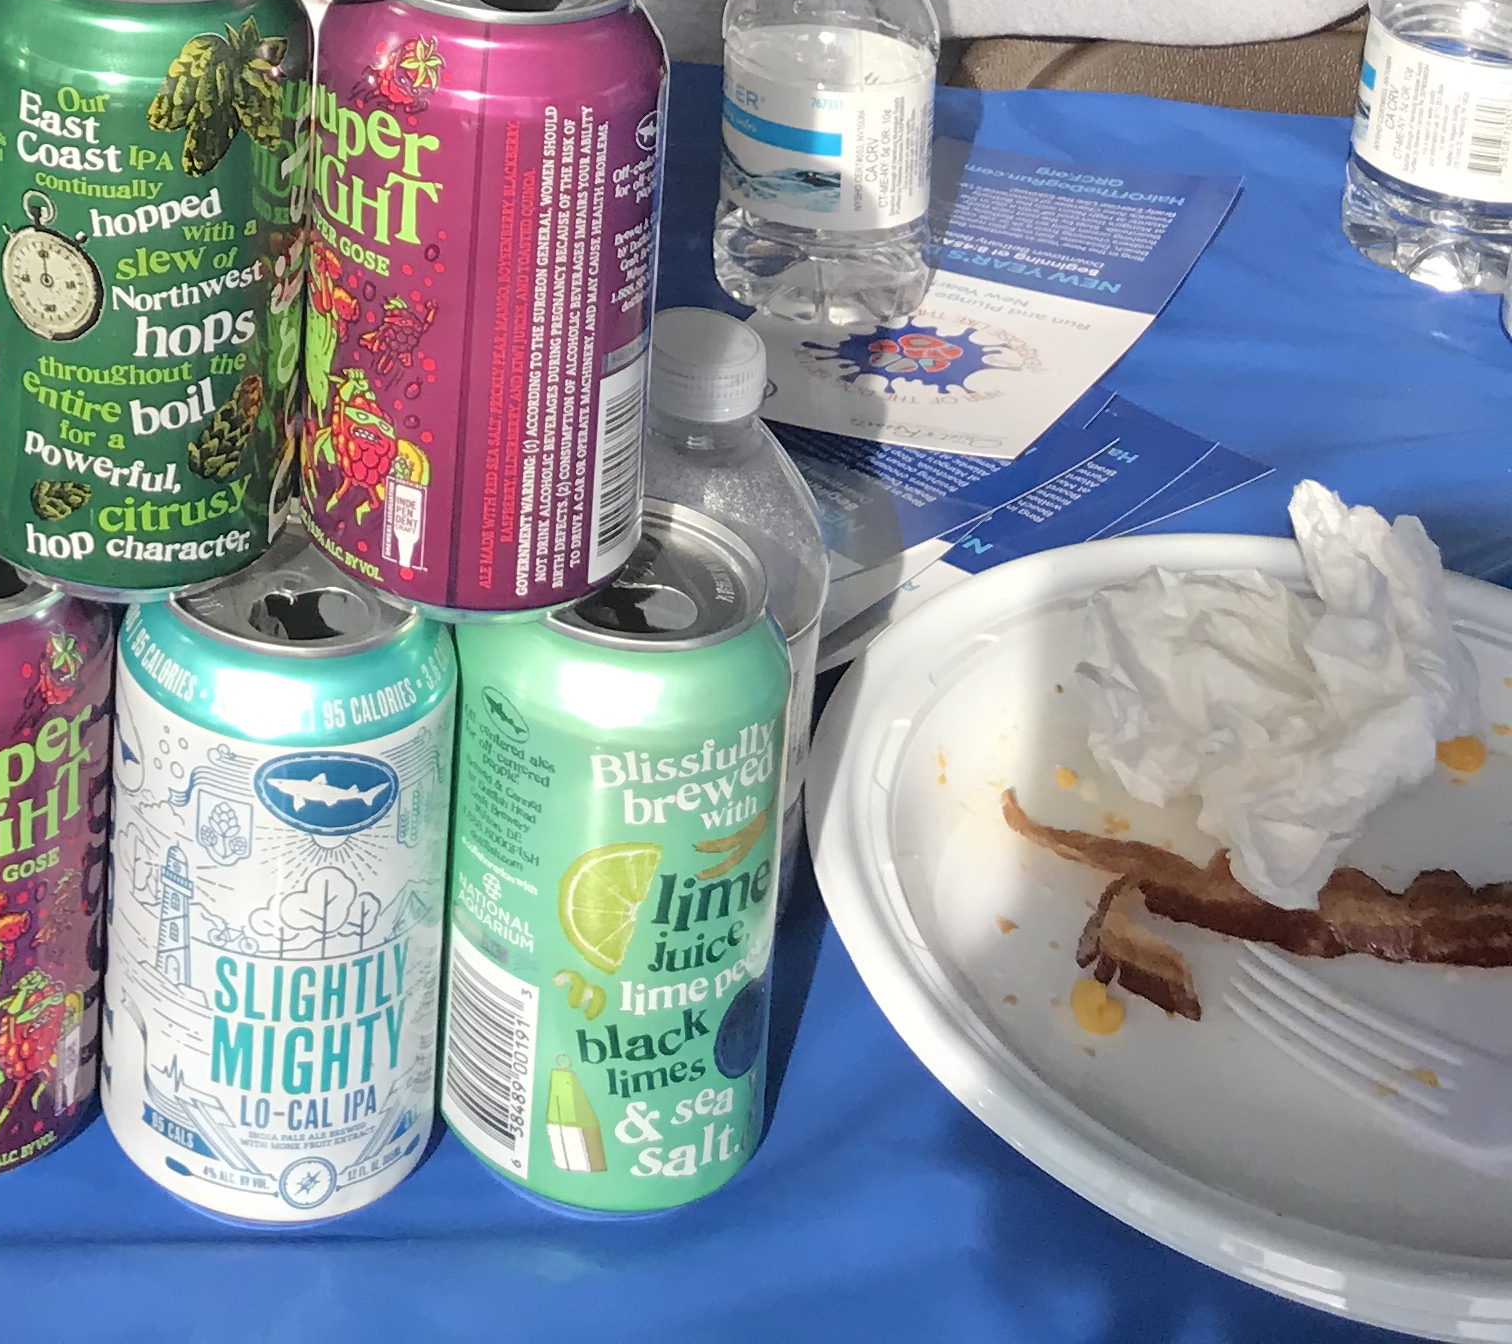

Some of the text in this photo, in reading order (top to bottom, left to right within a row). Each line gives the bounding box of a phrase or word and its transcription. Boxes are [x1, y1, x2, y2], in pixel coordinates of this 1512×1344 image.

[20, 89, 101, 145] East
[58, 86, 111, 114] Our
[17, 131, 175, 173] Coast IPA
[544, 105, 558, 158] SHOULD
[541, 160, 555, 207] WOMEN
[865, 137, 879, 184] CA CRV
[35, 171, 164, 201] continually
[90, 186, 223, 239] hopped
[182, 217, 236, 243] with
[115, 246, 239, 281] slew of
[339, 236, 391, 278] GOSE
[946, 248, 1122, 294] NEW YEAR'S
[112, 259, 264, 314] Northwest
[533, 268, 548, 324] SURGEON
[934, 291, 1004, 313] Plunge
[132, 308, 257, 359] hops
[532, 325, 545, 350] THE
[1008, 307, 1048, 323] and
[37, 352, 247, 386] throughout the
[530, 351, 543, 370] TO
[23, 369, 217, 436] entire boil
[525, 372, 542, 438] ACCORDING
[59, 418, 97, 445] for
[24, 430, 182, 495] powerful,
[520, 454, 537, 514] WARNING:
[98, 473, 252, 534] citrusy
[25, 522, 251, 563] hop character.
[515, 514, 533, 597] GOVERNMENT
[323, 678, 418, 730] 95 CALORIES
[591, 719, 776, 789] Blissfully
[623, 741, 774, 826] brewed
[700, 794, 758, 830] with
[2, 846, 61, 883] GOSE
[651, 858, 771, 933] lime
[213, 936, 410, 1023] SLIGHTLY
[620, 976, 710, 1016] lime
[210, 1003, 408, 1096] MIGHTY
[576, 1007, 711, 1066] black
[607, 1056, 707, 1099] limes
[240, 1084, 377, 1132] LO-CAL IPA
[615, 1086, 735, 1145] & sea
[630, 1122, 741, 1178] salt.
